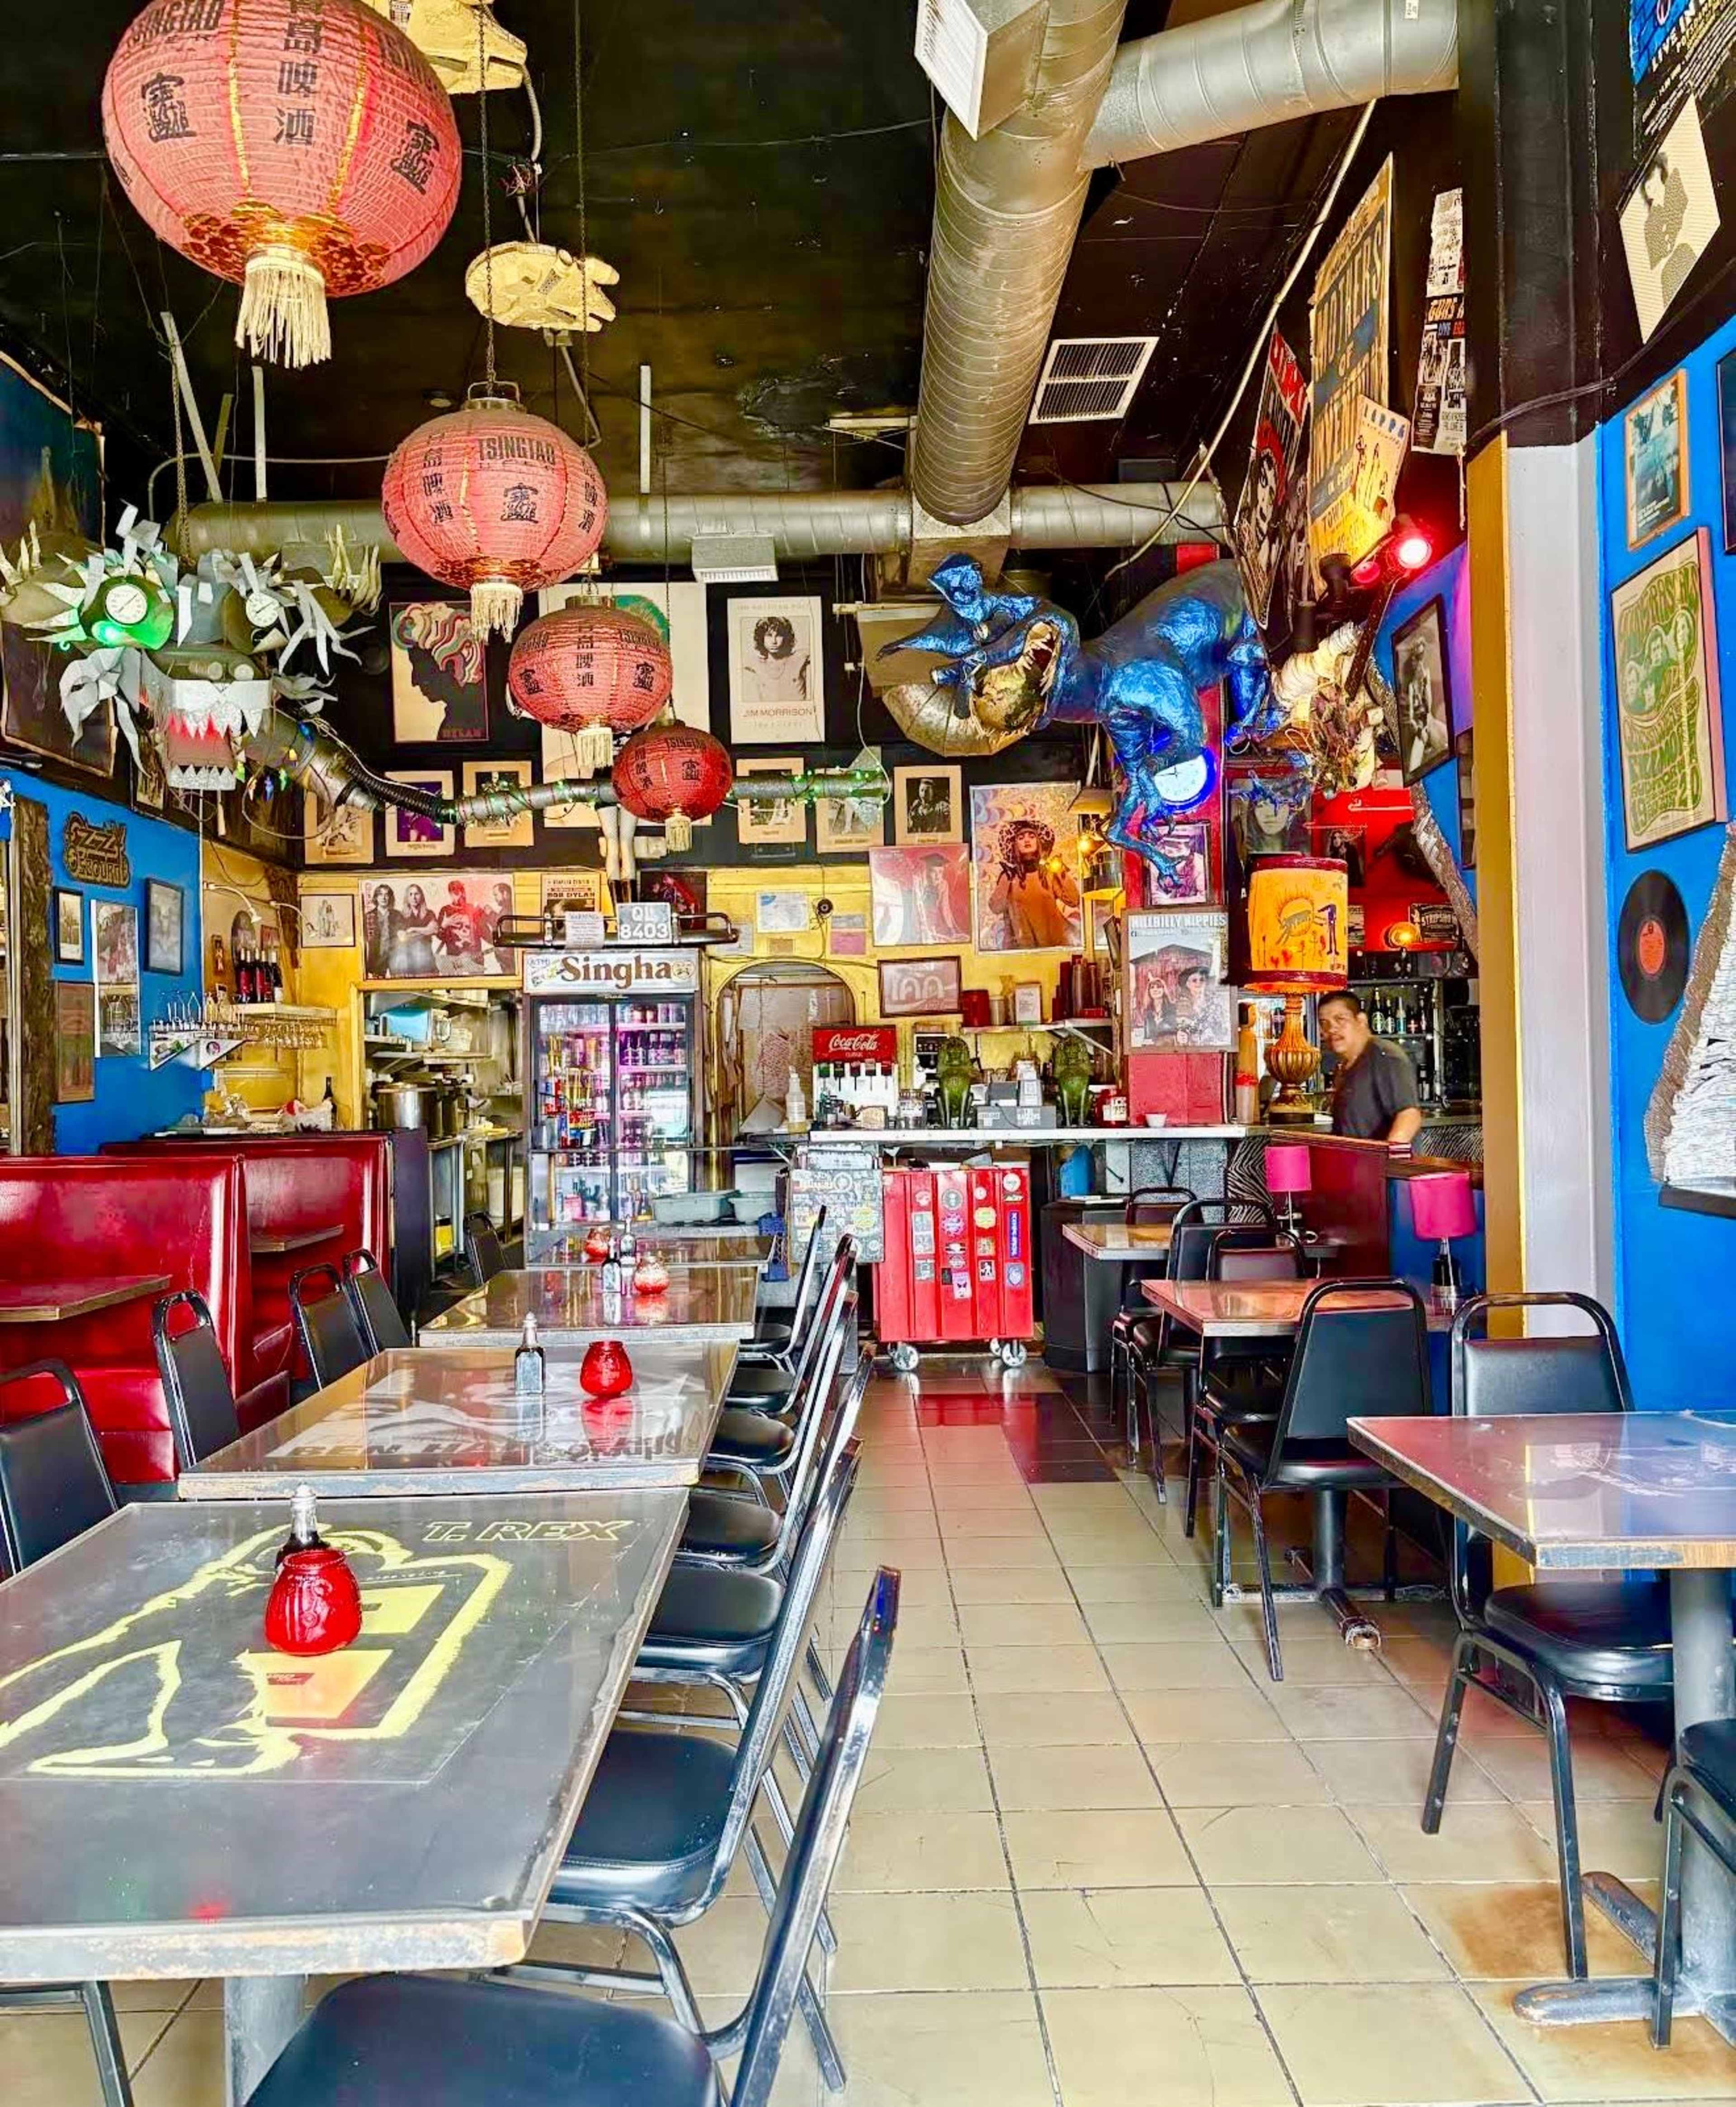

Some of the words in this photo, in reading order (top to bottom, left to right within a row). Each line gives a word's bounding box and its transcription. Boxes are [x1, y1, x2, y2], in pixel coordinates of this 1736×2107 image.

[1651, 26, 1678, 72] LIVE
[477, 435, 557, 466] TSINGTAO
[761, 708, 812, 717] MORRISON
[620, 922, 669, 939] 8403
[561, 954, 672, 989] Singha
[828, 1033, 880, 1053] Coca-Cola
[475, 1520, 634, 1541] REX
